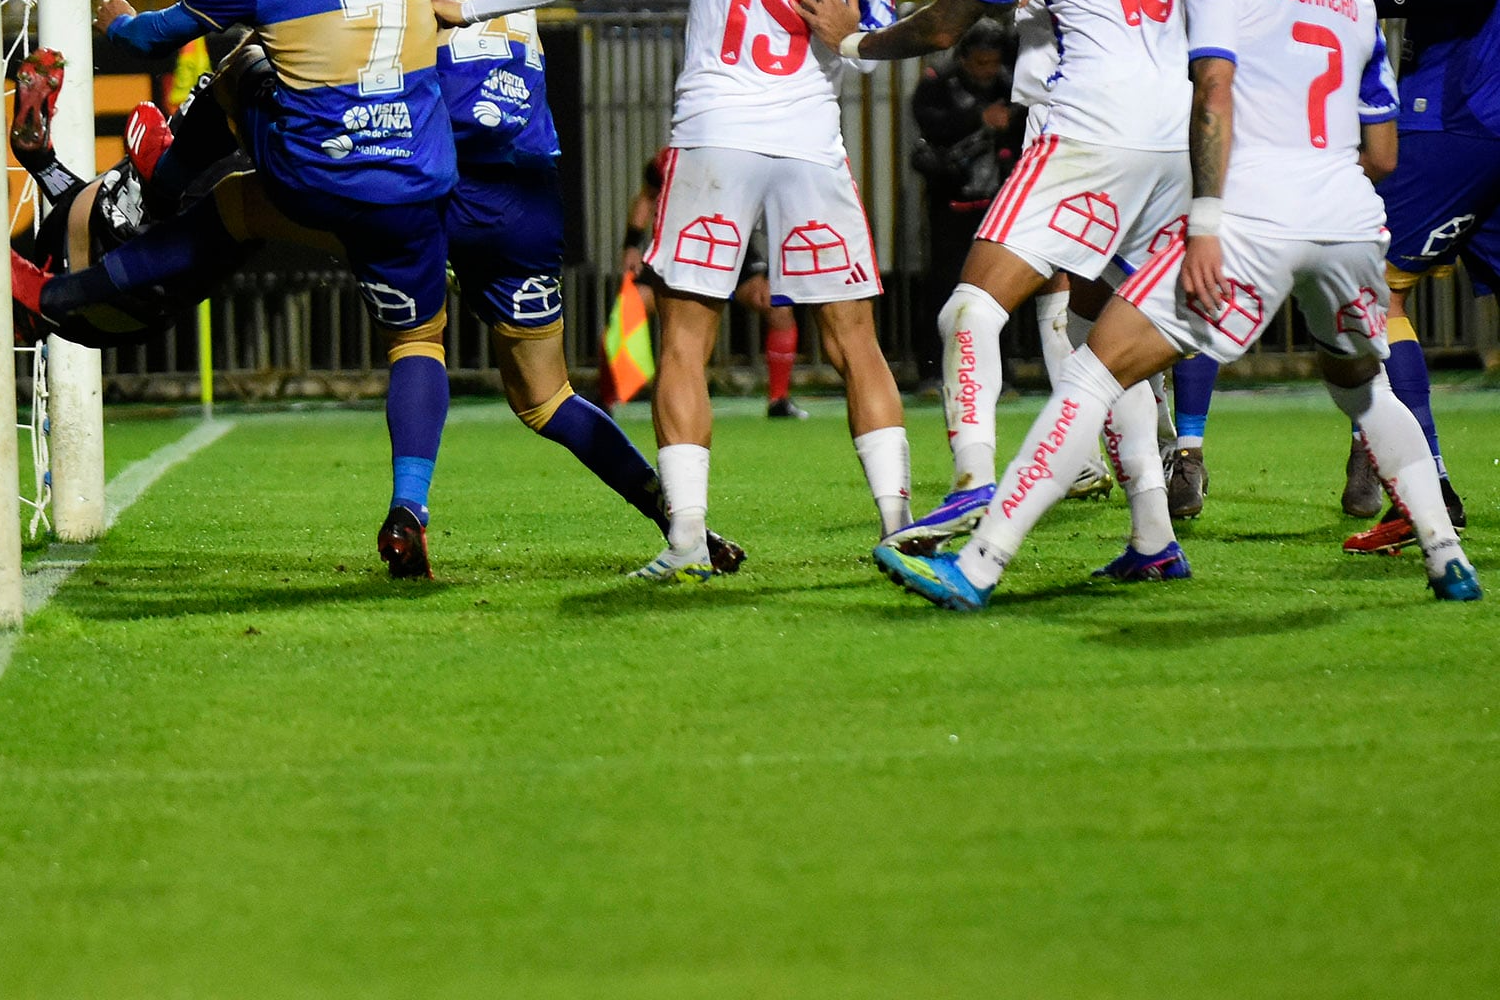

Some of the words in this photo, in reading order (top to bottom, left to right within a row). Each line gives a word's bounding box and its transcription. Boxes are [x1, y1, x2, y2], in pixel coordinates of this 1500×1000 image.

[367, 101, 410, 116] VISITA
[1291, 20, 1344, 150] 7
[954, 329, 983, 426] AutoPlanet
[1001, 397, 1081, 520] AutoPlanet
